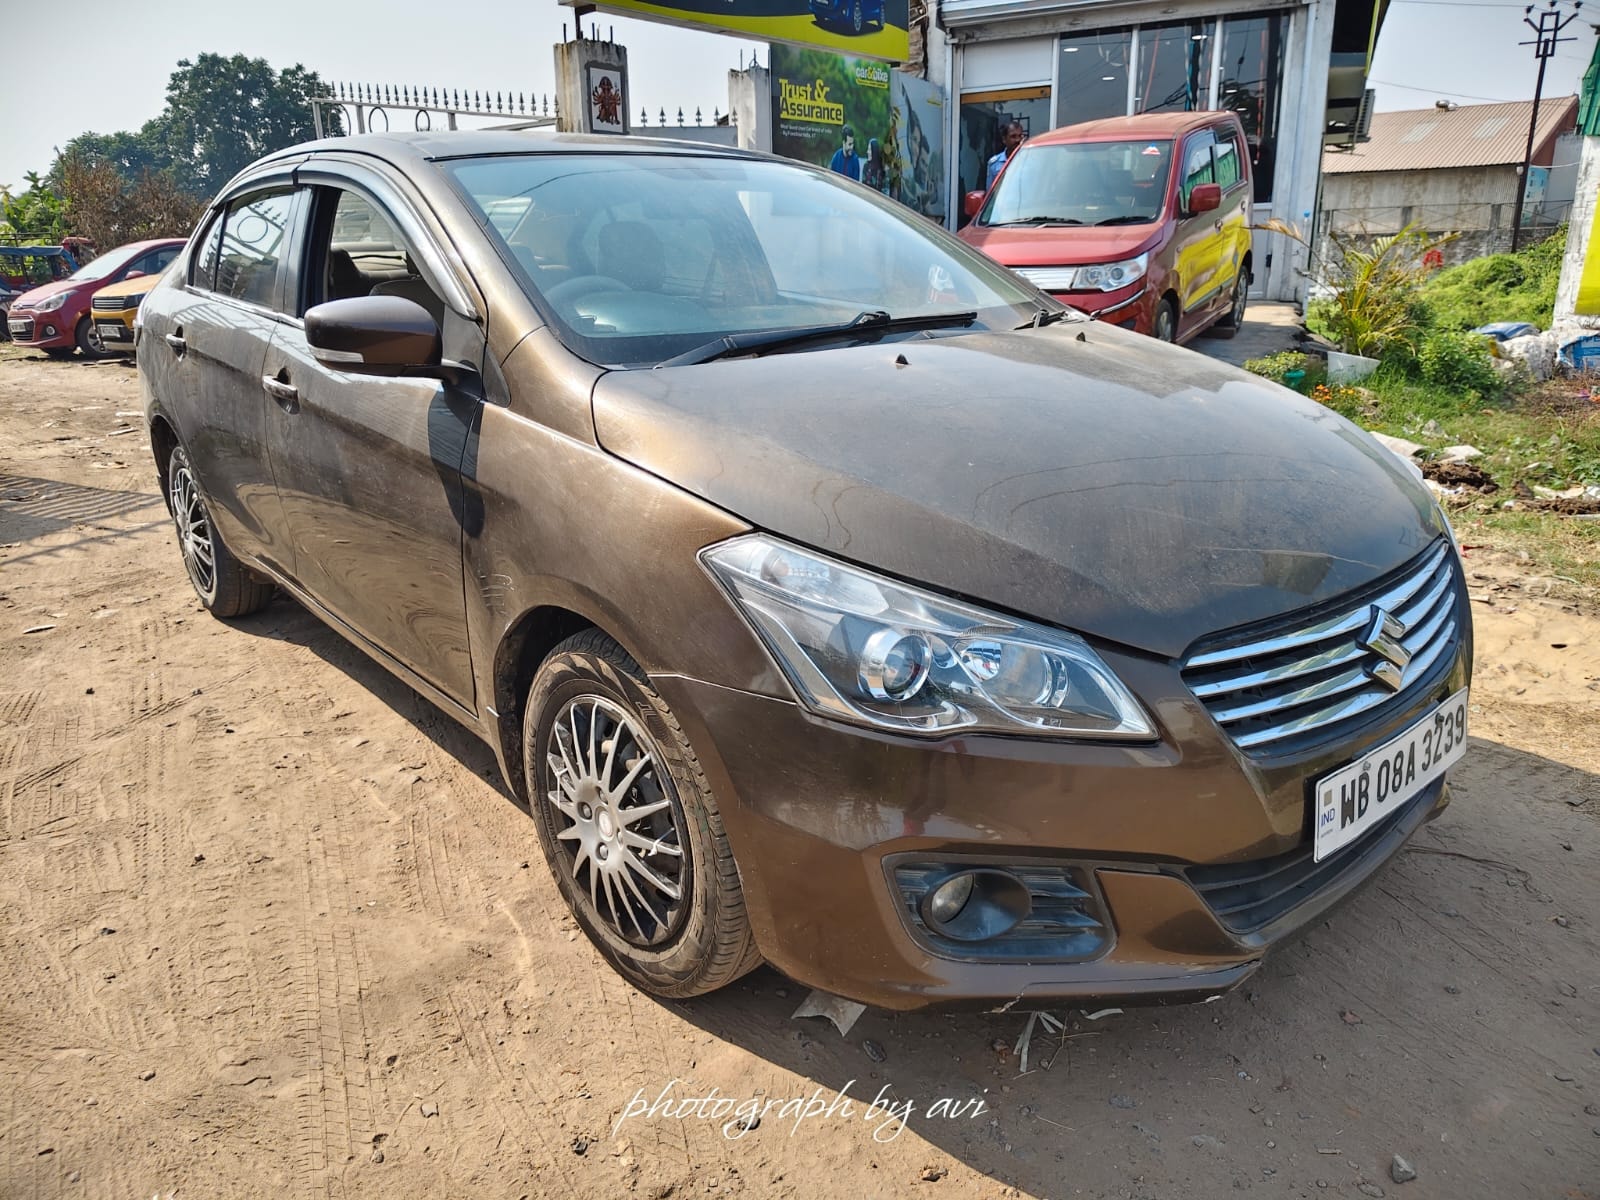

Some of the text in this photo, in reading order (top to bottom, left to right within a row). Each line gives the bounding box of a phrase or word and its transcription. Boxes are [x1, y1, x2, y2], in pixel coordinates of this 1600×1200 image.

[856, 66, 888, 82] car&bike
[778, 78, 830, 102] Trust &
[780, 96, 842, 122] Assurance
[1340, 704, 1465, 830] WB 08A 3239
[1320, 807, 1335, 827] IND
